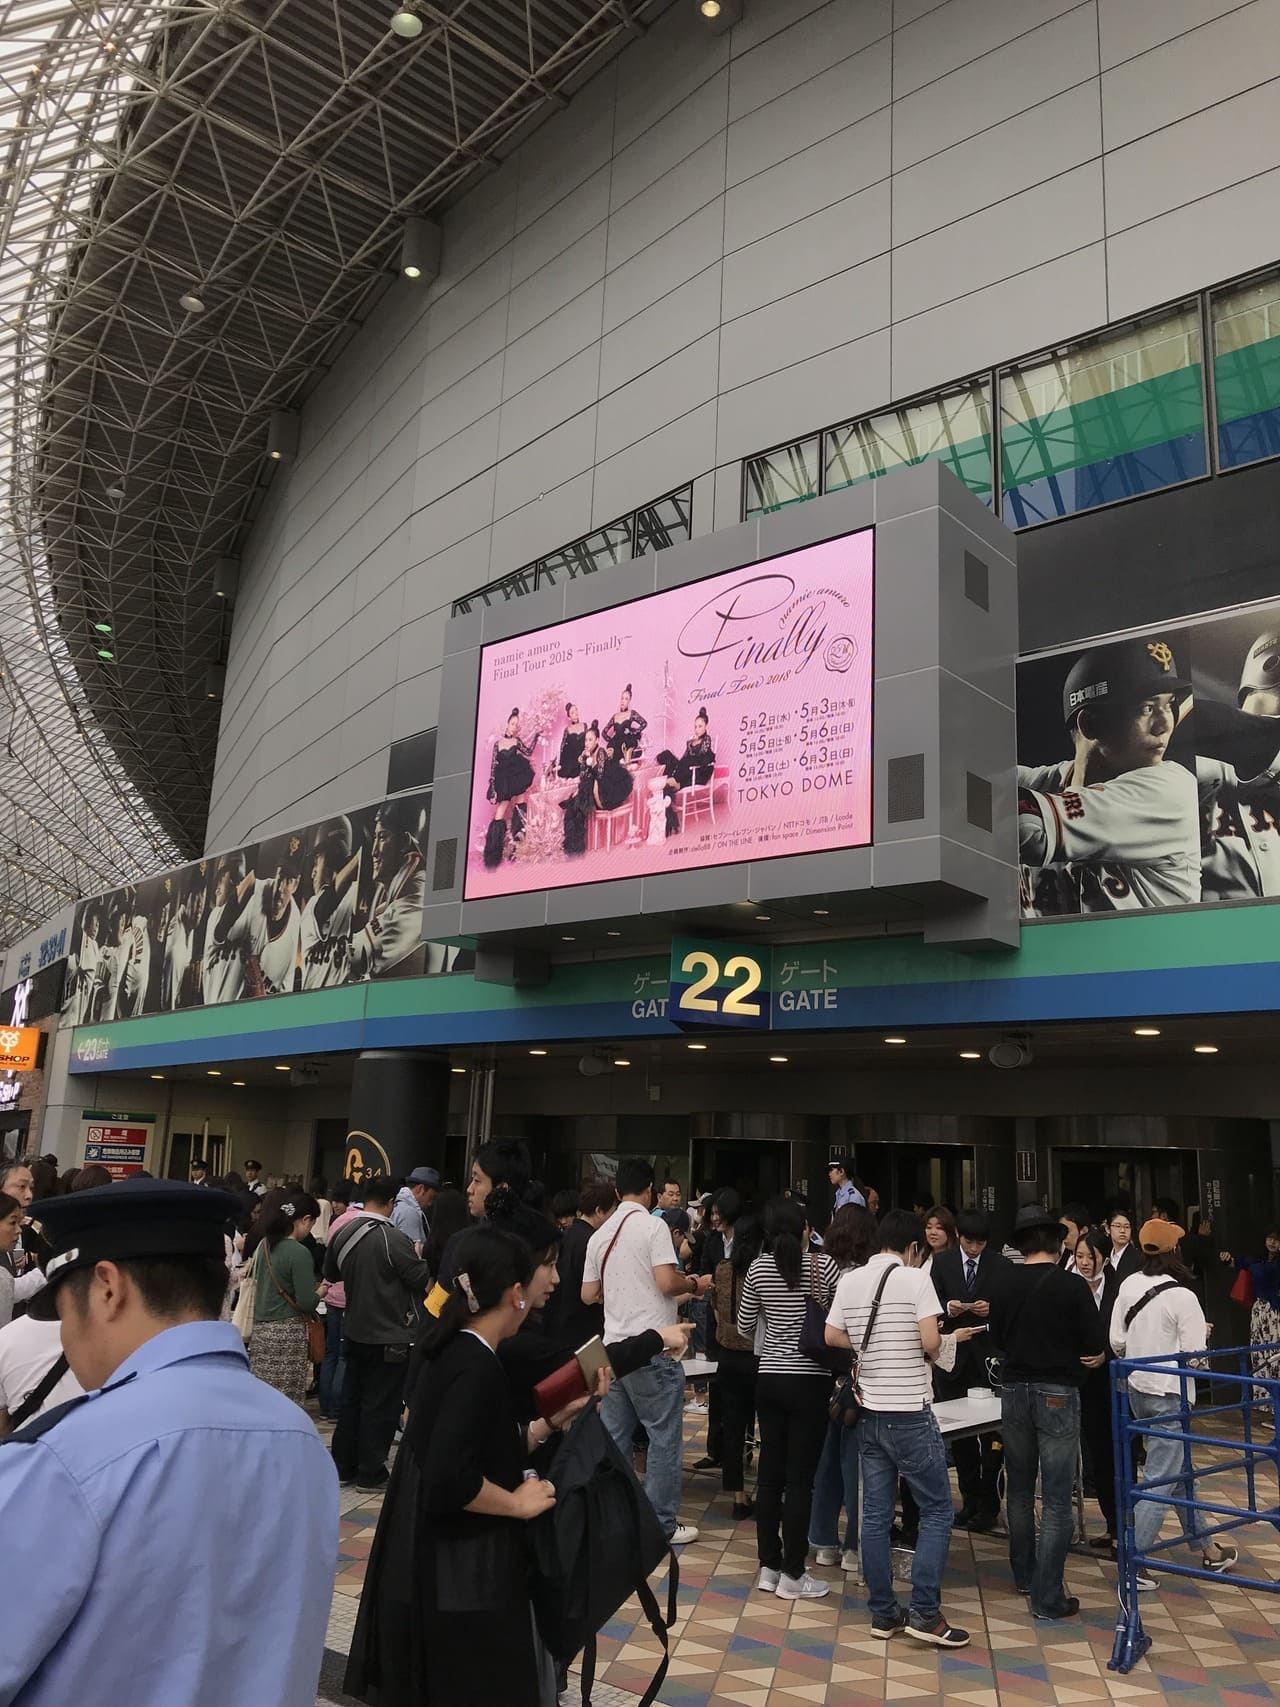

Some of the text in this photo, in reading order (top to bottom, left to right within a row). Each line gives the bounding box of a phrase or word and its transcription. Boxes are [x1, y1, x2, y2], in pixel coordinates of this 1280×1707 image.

[677, 574, 828, 683] Finally
[493, 664, 519, 681] Final
[522, 659, 547, 673] Tour
[549, 648, 573, 666] 2018
[494, 641, 561, 667] namie amuro
[766, 669, 792, 686] 2018
[737, 780, 794, 803] TOKYO
[802, 770, 853, 793] DOME
[634, 971, 668, 995] ゲー
[679, 951, 762, 1017] 22
[780, 959, 838, 985] ゲート
[632, 998, 669, 1019] GAT
[779, 988, 838, 1012] GATE
